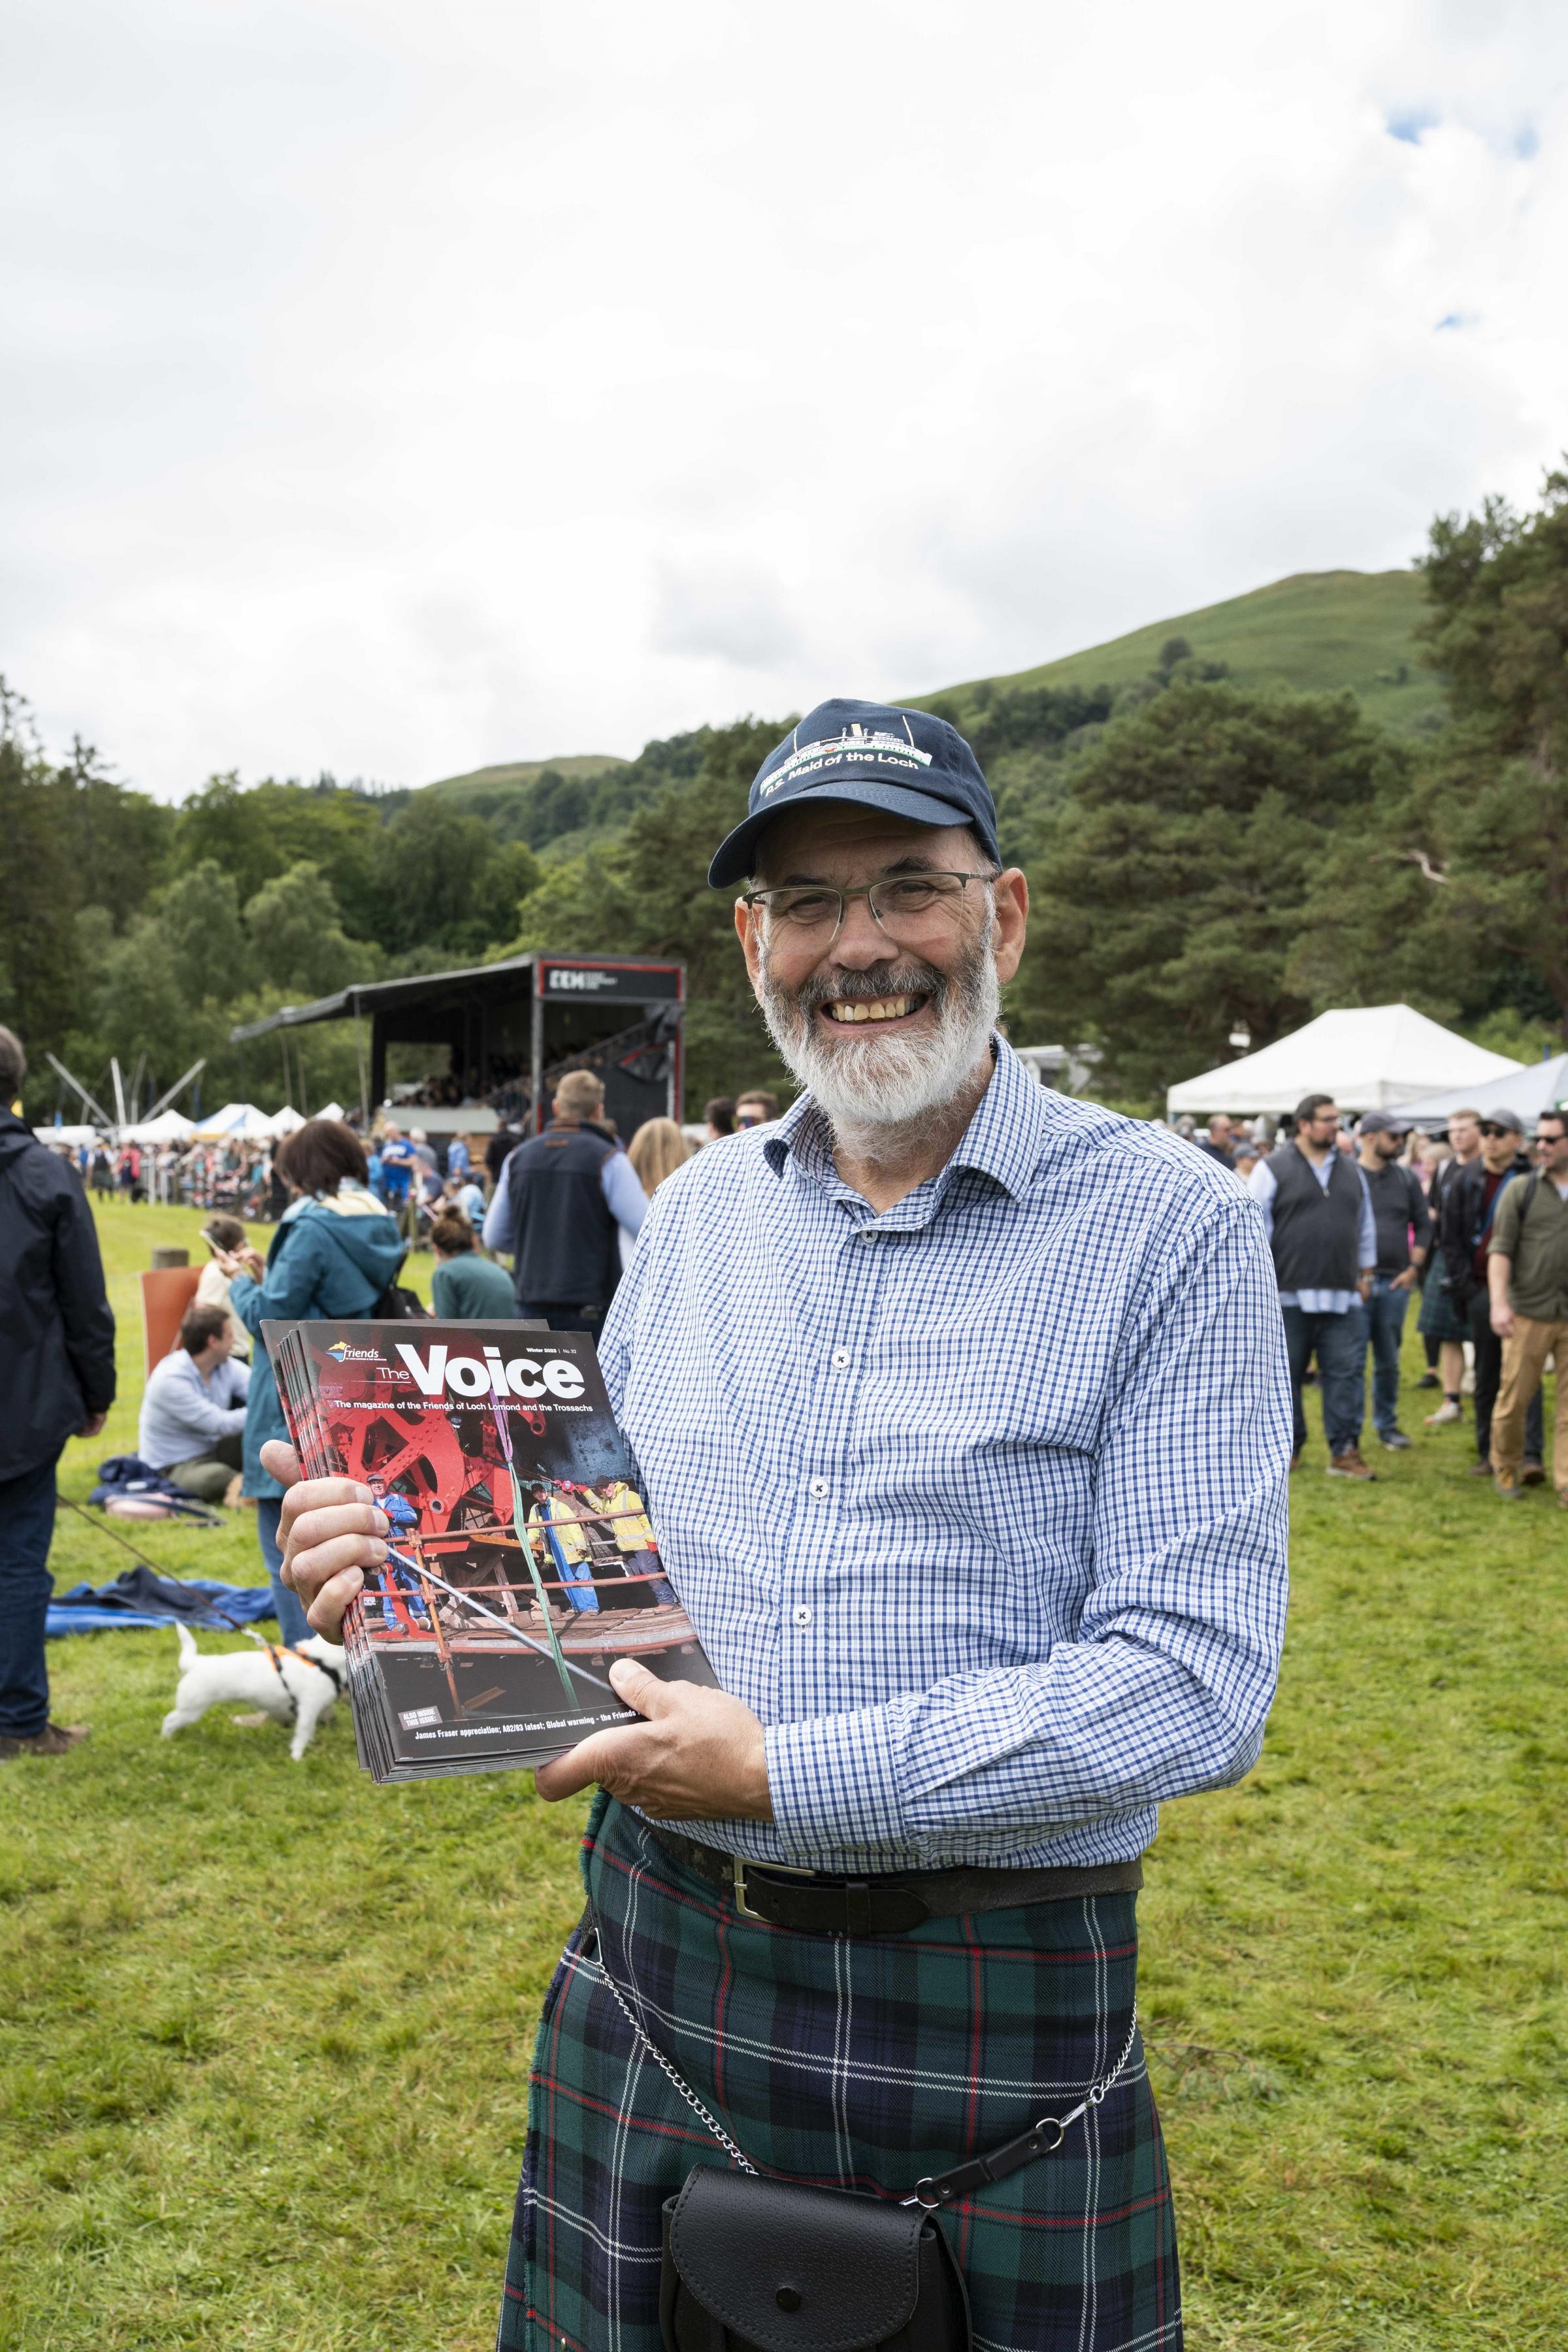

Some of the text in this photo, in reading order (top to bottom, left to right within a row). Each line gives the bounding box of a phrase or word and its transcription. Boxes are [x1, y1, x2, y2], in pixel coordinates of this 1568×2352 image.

[788, 758, 823, 780] Maid
[825, 753, 843, 766] of
[846, 752, 874, 762] the
[877, 753, 919, 770] Loch
[376, 1344, 585, 1399] The Voice
[403, 1708, 436, 1720] ALSO INSIDE
[406, 1718, 419, 1727] THIS
[415, 1731, 436, 1740] James
[437, 1729, 458, 1738] Fraser
[460, 1726, 502, 1738] appreciation;
[502, 1723, 523, 1733] A82/83
[525, 1722, 546, 1731] latest;
[546, 1720, 566, 1729] Global
[567, 1716, 595, 1727] warming
[612, 1710, 636, 1720] Friends
